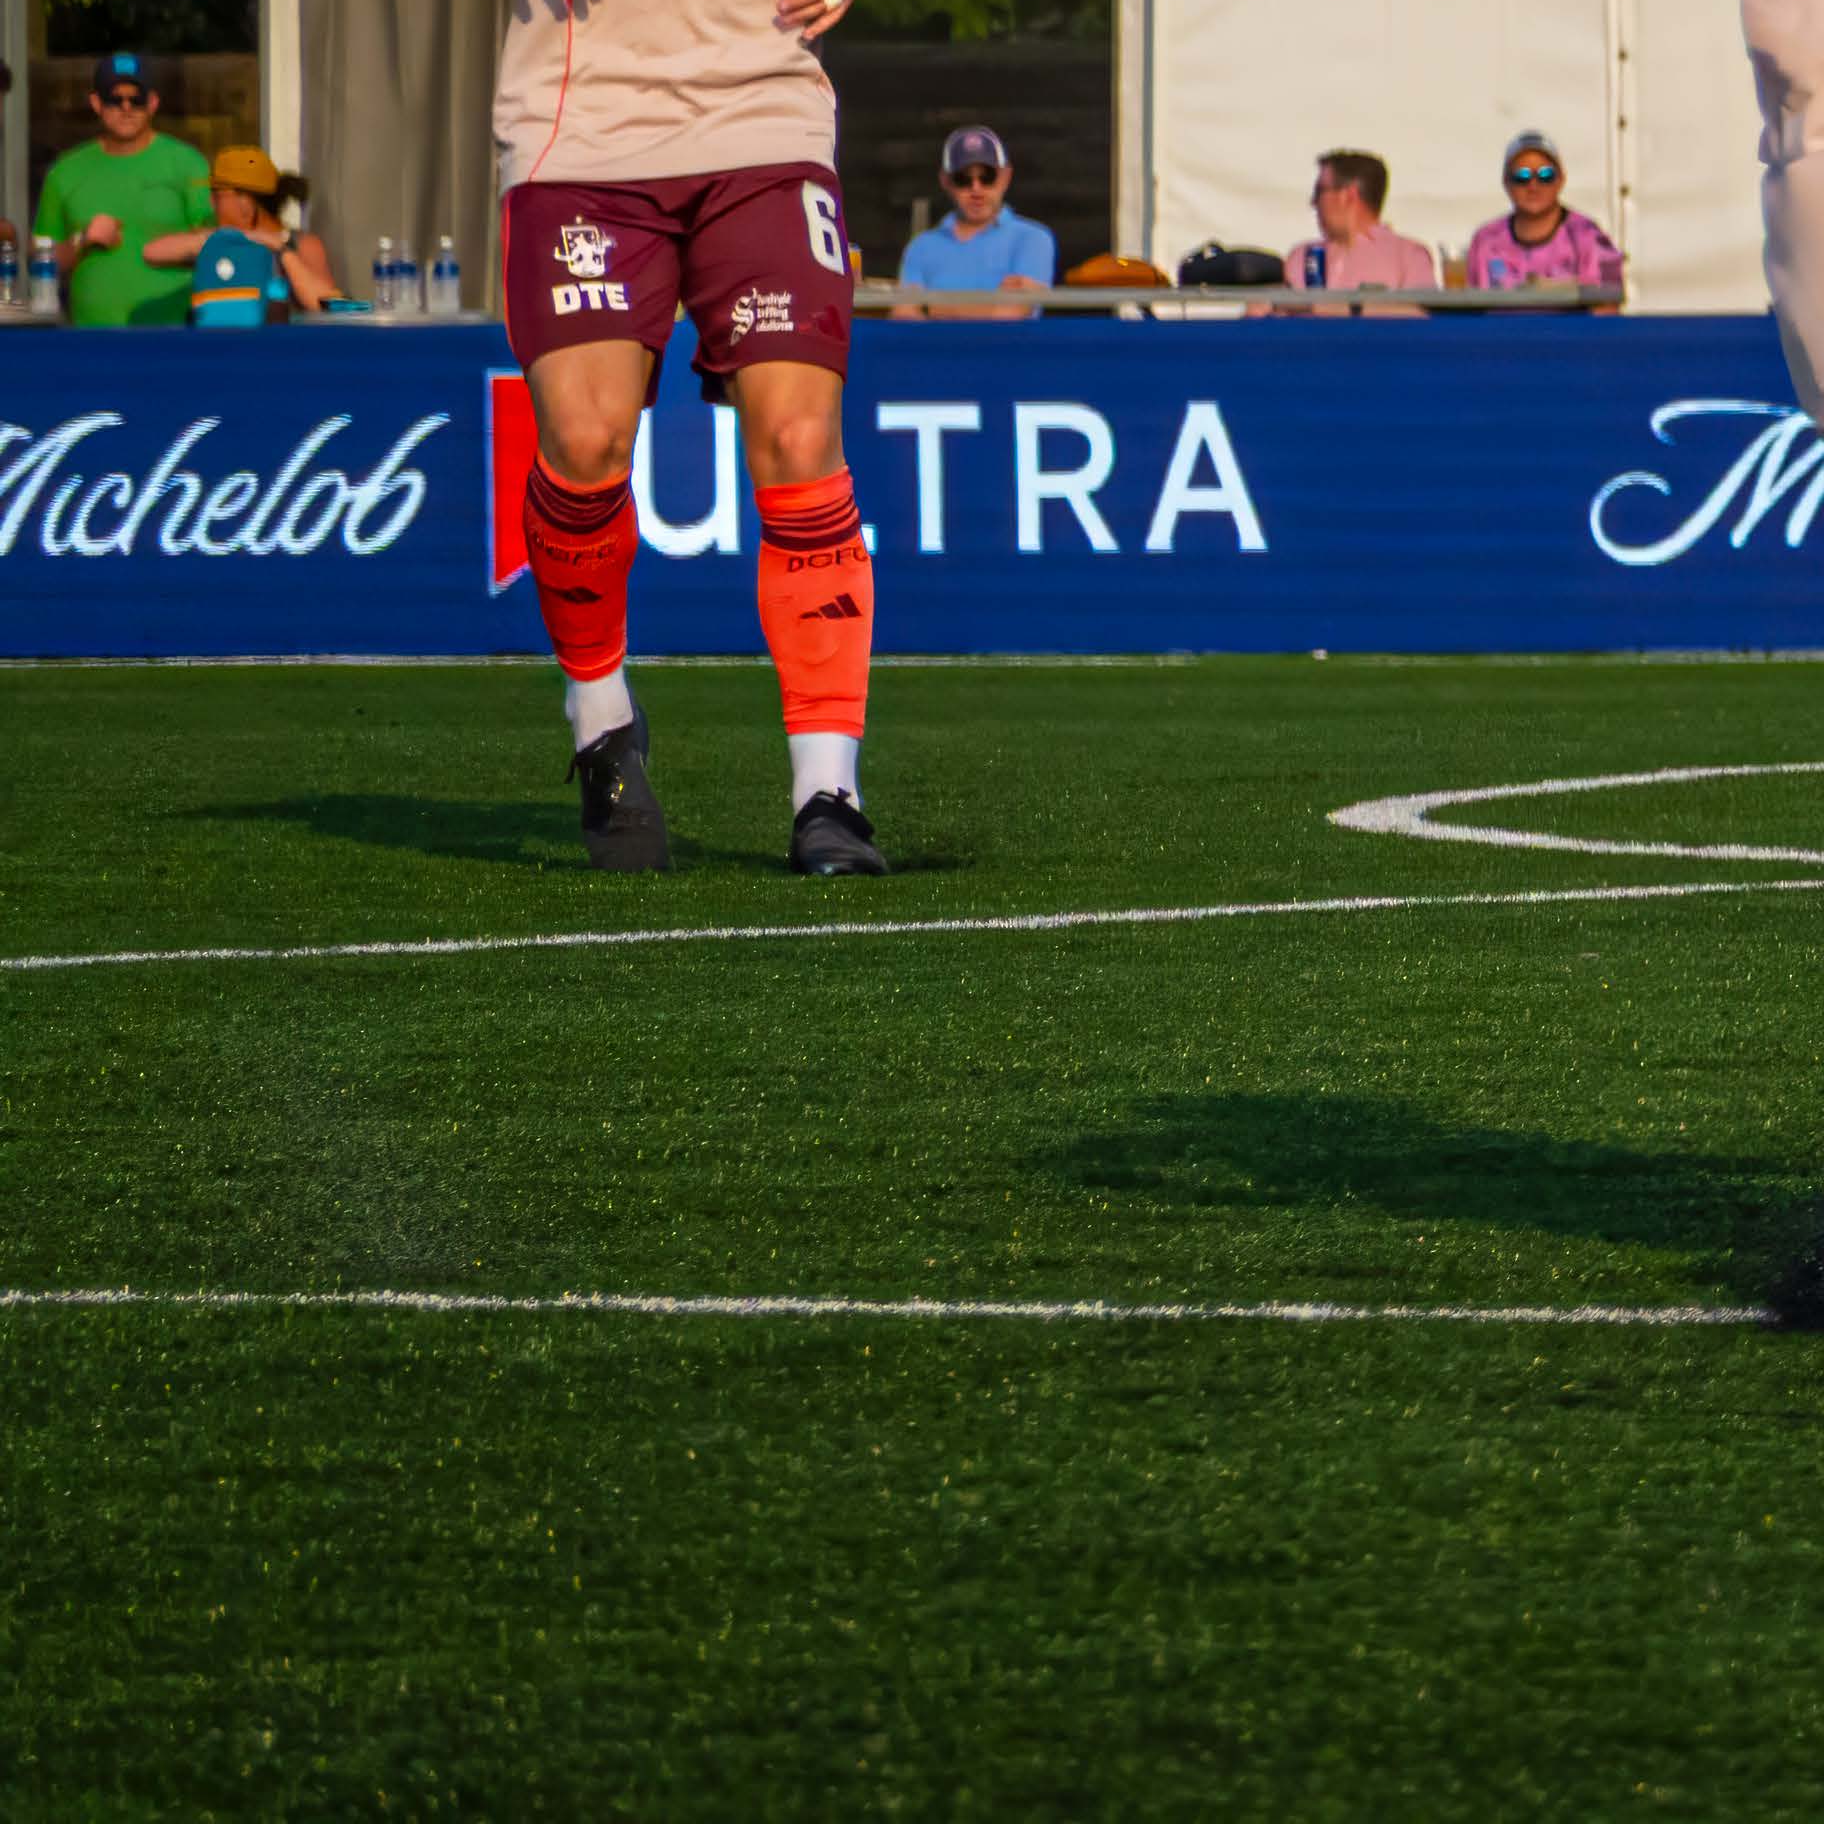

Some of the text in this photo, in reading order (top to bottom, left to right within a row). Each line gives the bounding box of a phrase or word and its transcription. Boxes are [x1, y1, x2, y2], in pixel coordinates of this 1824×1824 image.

[801, 179, 846, 276] 6
[552, 282, 630, 317] DTE
[628, 399, 1267, 560] UTRA
